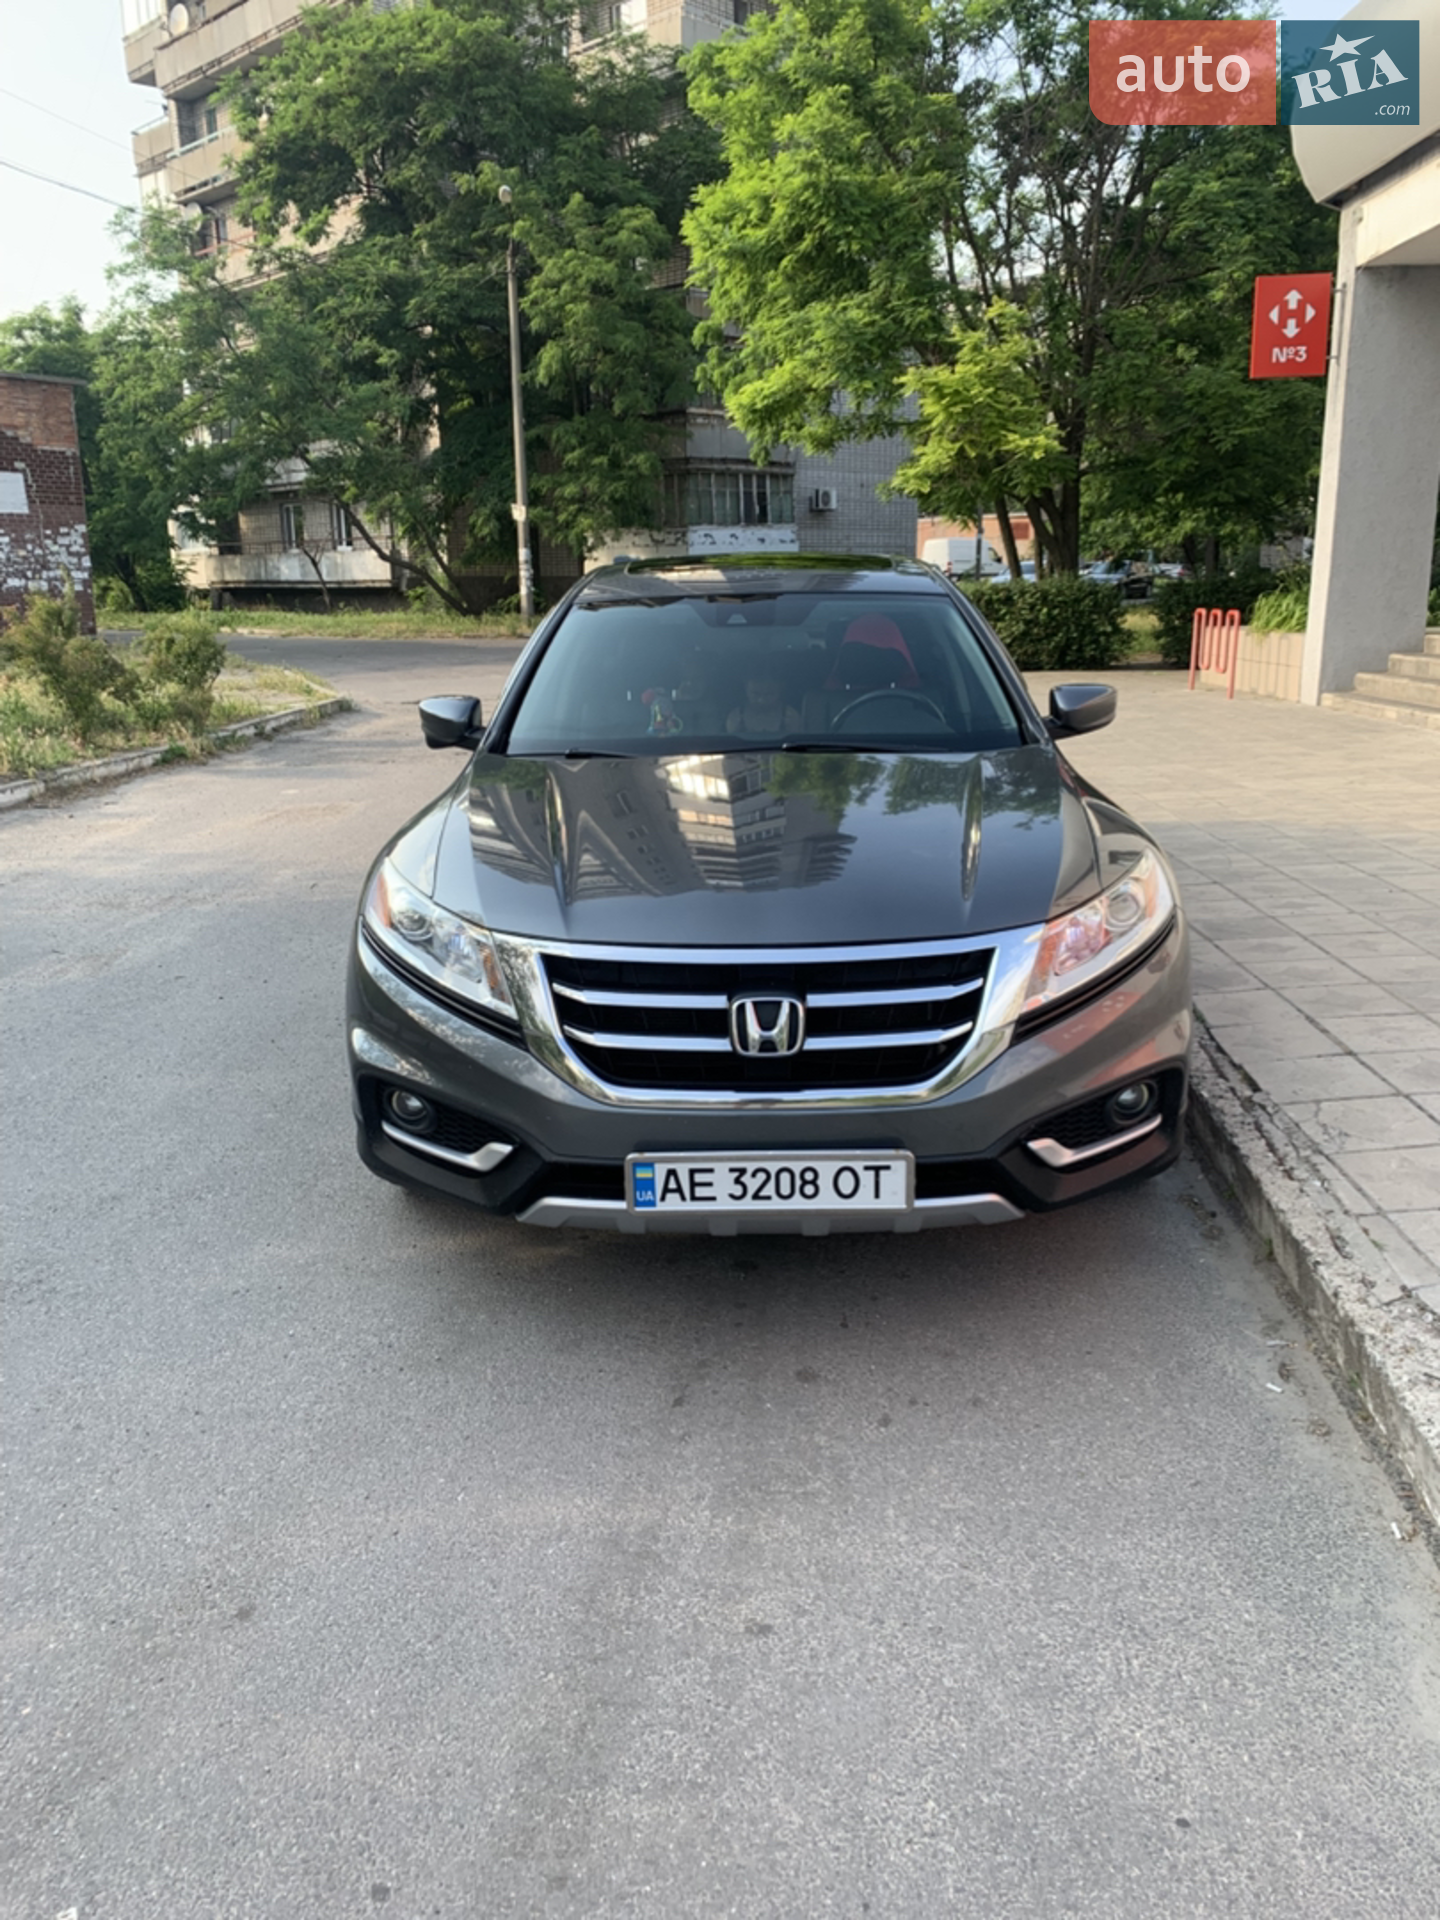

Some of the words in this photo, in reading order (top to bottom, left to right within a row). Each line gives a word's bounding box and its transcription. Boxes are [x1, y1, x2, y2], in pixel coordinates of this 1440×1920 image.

[659, 1167, 717, 1202] AE
[727, 1166, 820, 1200] 3208
[832, 1165, 892, 1200] OT
[636, 1190, 655, 1202] UA
